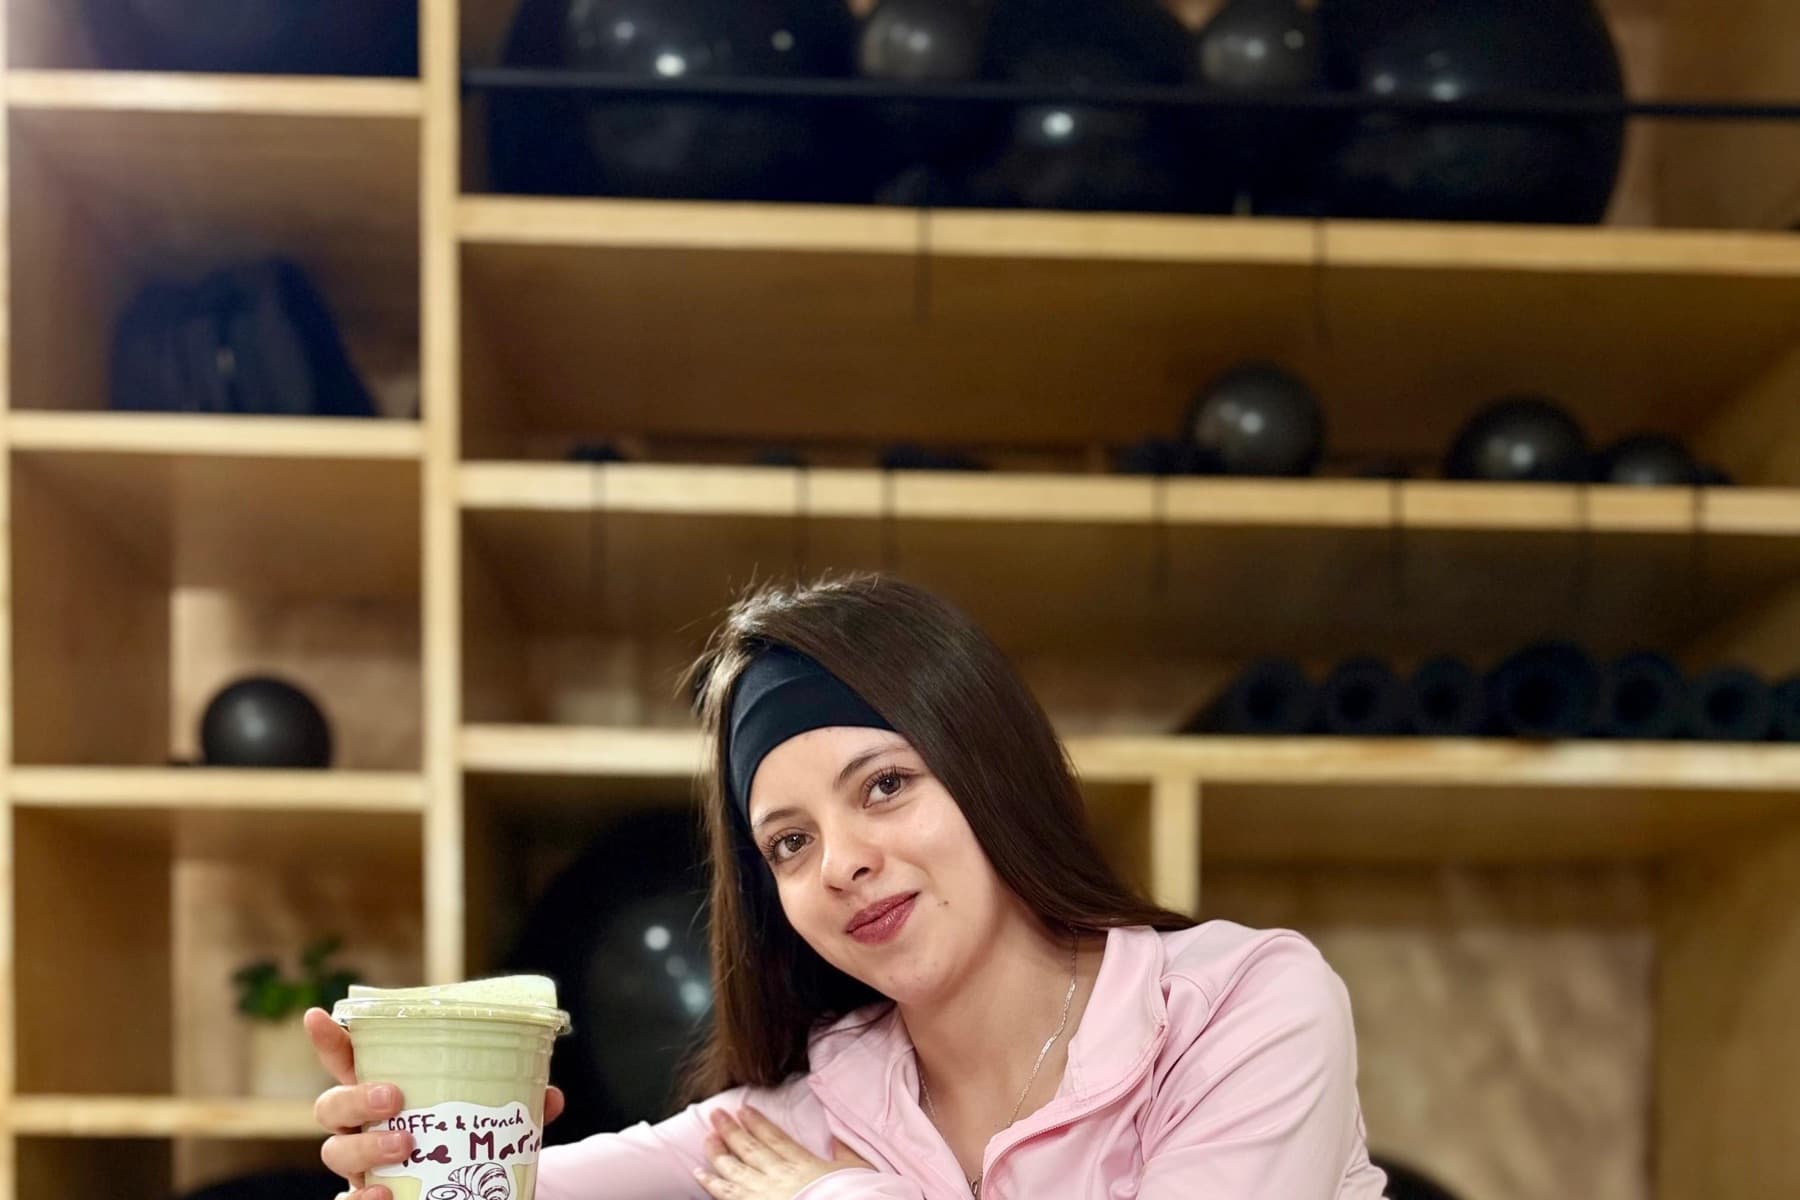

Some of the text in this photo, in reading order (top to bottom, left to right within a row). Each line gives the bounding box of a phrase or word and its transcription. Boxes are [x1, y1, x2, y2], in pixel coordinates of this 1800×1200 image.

[456, 1115, 466, 1131] &
[473, 1109, 524, 1129] brunch
[402, 1144, 452, 1167] ce
